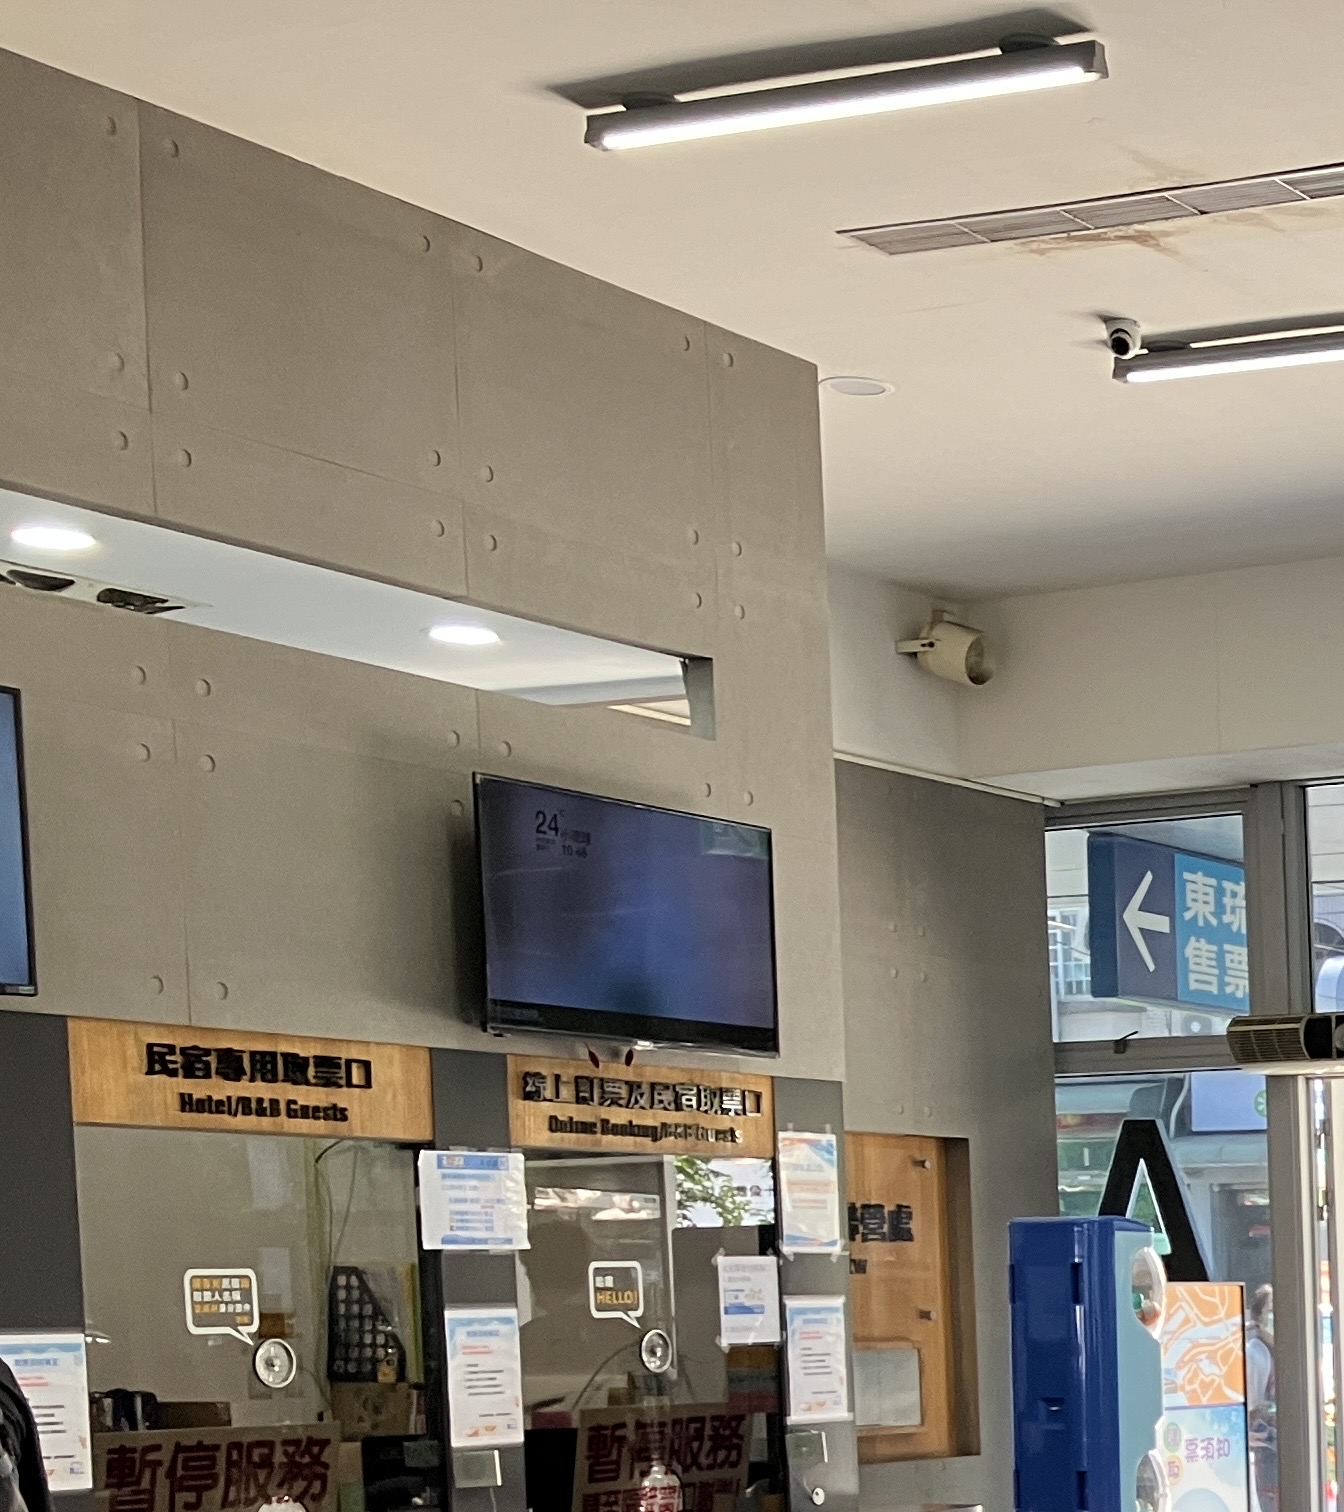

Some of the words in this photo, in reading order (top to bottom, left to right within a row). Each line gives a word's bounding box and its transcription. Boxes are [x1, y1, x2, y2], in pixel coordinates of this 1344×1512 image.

[535, 810, 559, 836] 24
[1183, 871, 1246, 934] 東琉
[1184, 936, 1249, 998] 售票
[145, 1042, 372, 1089] 民宿專用取票口
[178, 1092, 281, 1118] Hotel/B&B
[285, 1098, 348, 1122] Guests
[597, 1290, 637, 1304] HELLO!
[587, 1414, 746, 1484] 暫停服務
